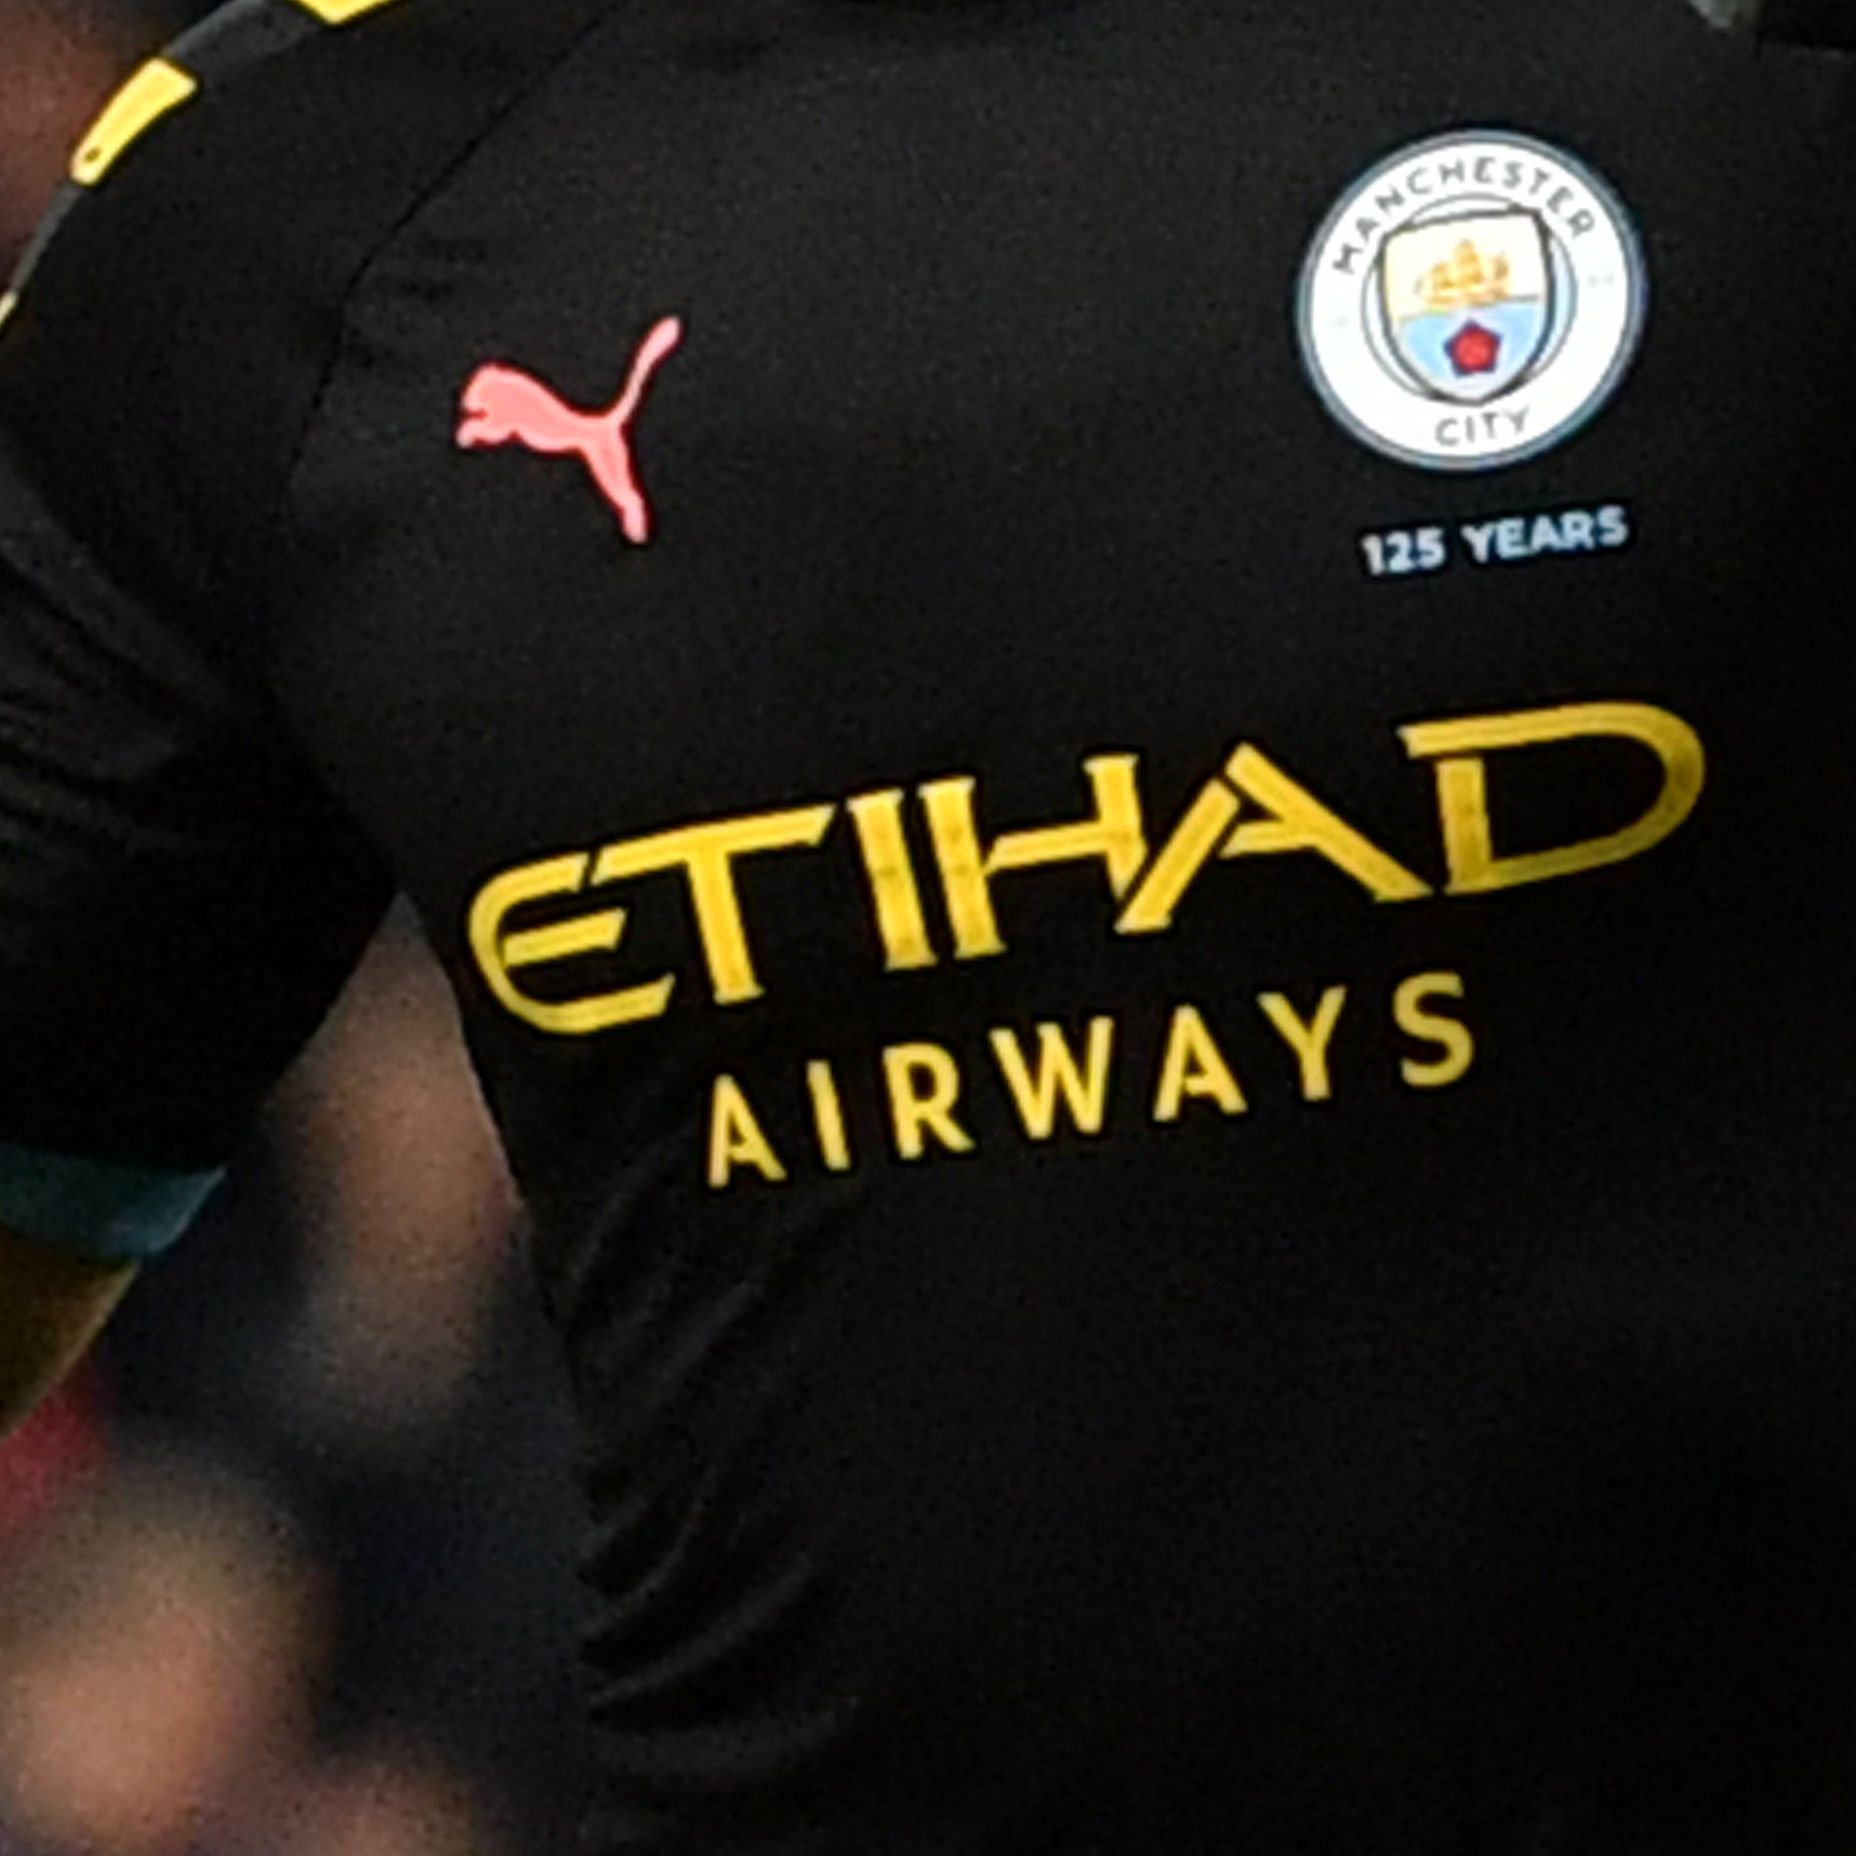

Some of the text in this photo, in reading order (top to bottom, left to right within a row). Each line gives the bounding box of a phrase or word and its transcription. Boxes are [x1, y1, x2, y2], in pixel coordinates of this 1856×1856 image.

[1332, 155, 1596, 275] MANCHESTER
[1434, 406, 1530, 447] CITY
[1361, 505, 1630, 576] 125 YEARS
[467, 701, 1706, 1034] ETIHAD
[707, 972, 1477, 1188] AIRWAYS
